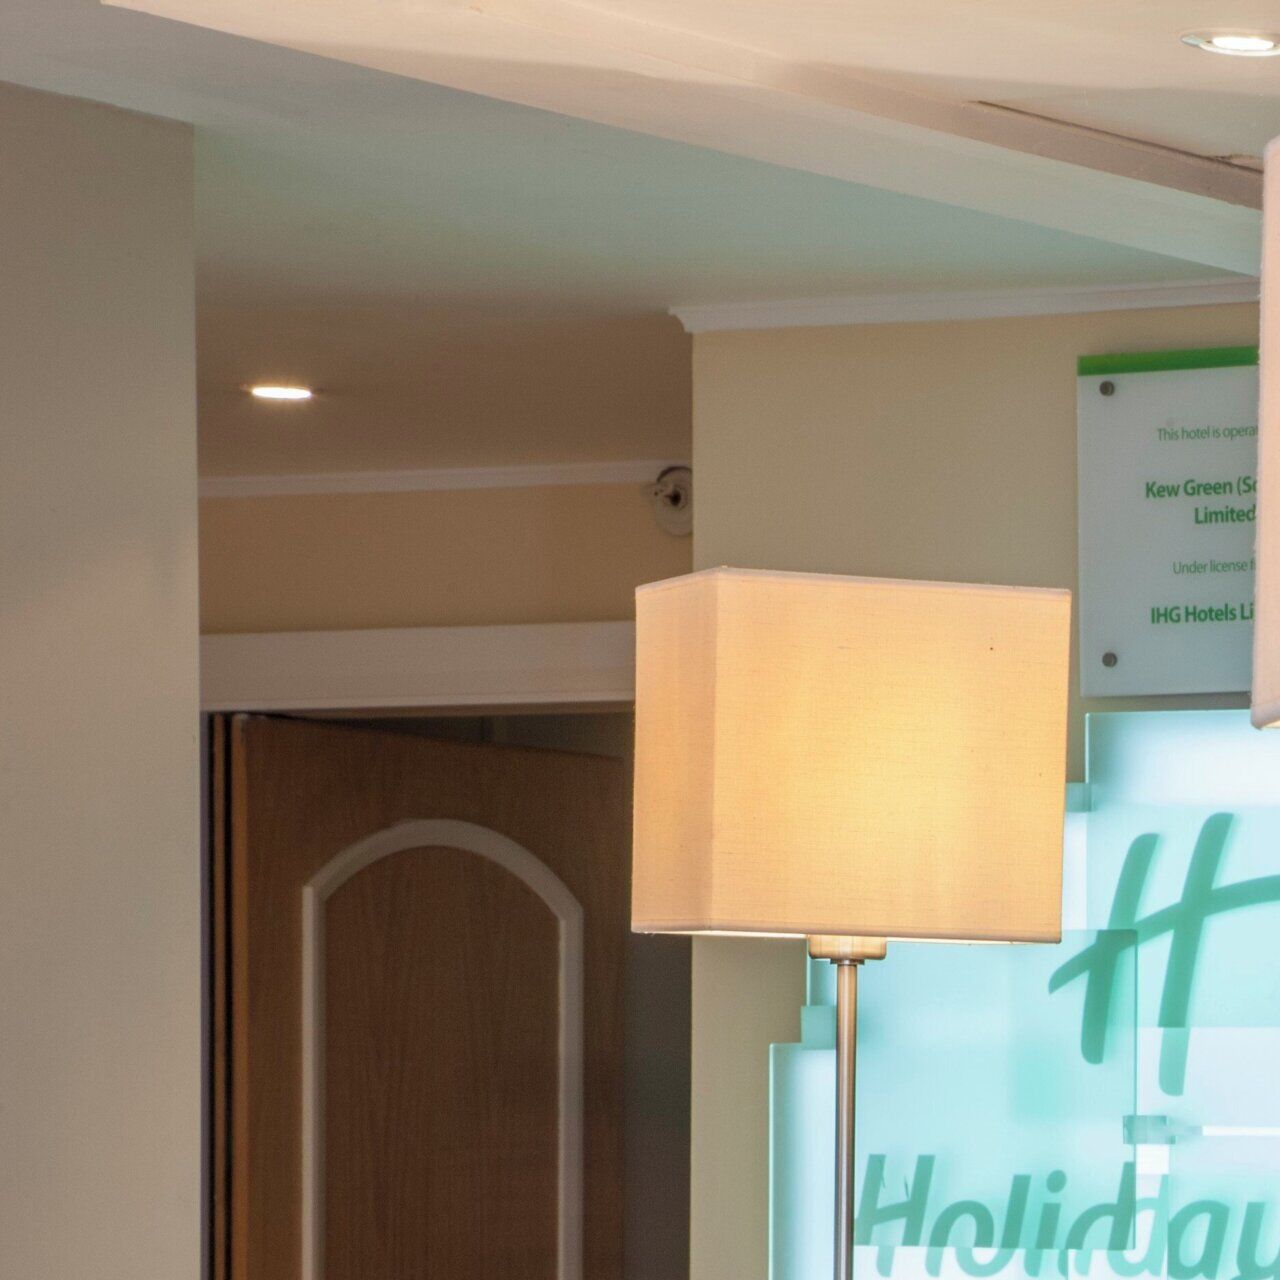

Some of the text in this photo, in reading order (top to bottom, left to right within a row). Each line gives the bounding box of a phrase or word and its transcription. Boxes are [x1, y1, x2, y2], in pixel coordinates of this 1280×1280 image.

[1157, 427, 1180, 441] This
[1181, 426, 1211, 440] hotel
[1212, 426, 1221, 438] is
[1145, 481, 1181, 498] Kew
[1183, 479, 1233, 496] Green
[1194, 503, 1257, 524] Limited
[1173, 560, 1208, 574] Under
[1209, 559, 1248, 573] license
[1151, 602, 1255, 624] IHG Hotels Li
